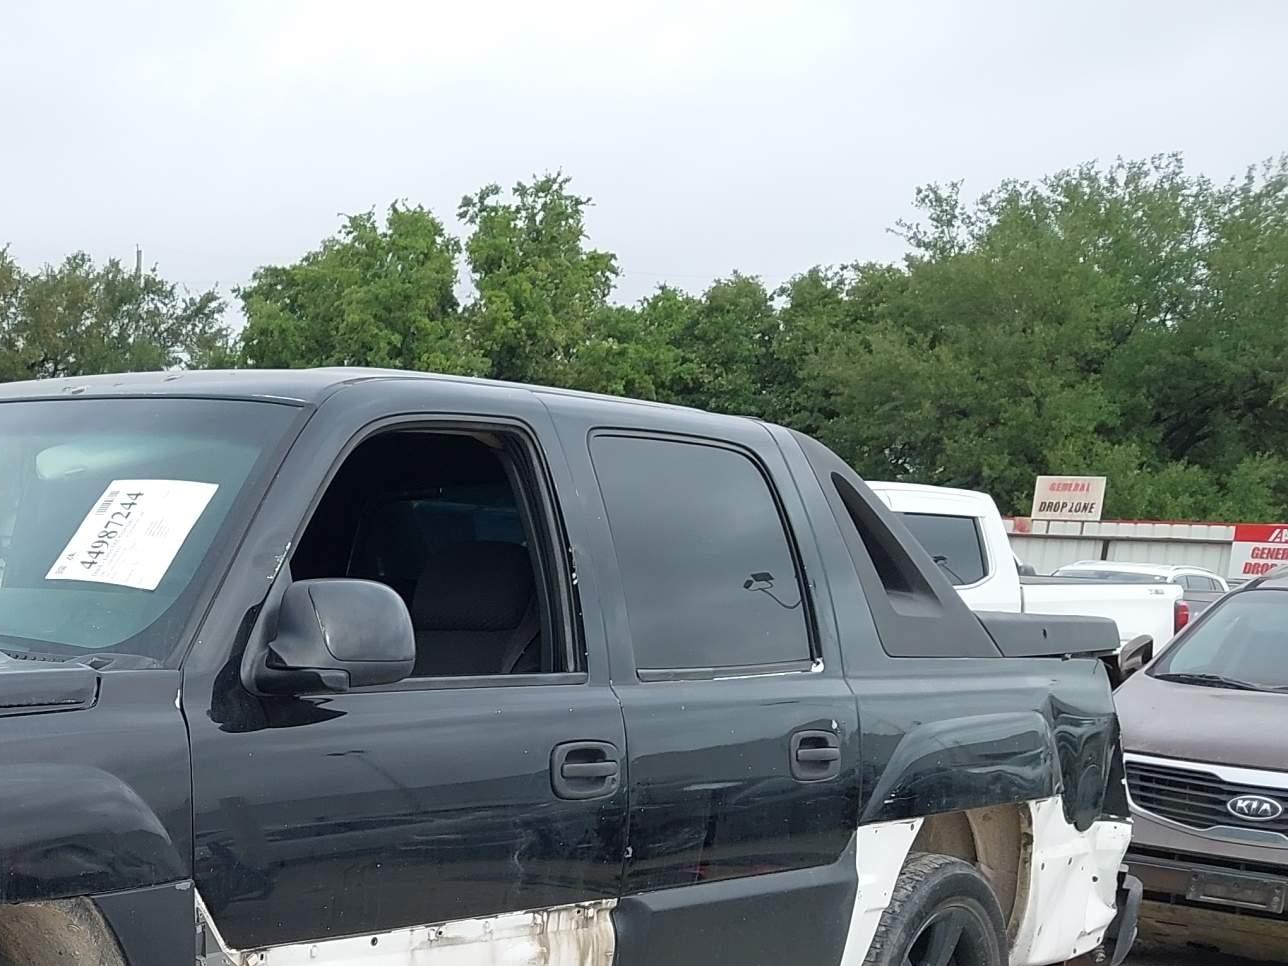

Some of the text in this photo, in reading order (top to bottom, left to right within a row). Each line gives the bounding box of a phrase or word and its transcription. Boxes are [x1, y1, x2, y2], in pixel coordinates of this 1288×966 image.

[1049, 482, 1090, 492] GENERAL
[1039, 501, 1096, 513] DROP ZONE
[80, 492, 144, 570] 44987244
[1235, 799, 1272, 816] KIA
